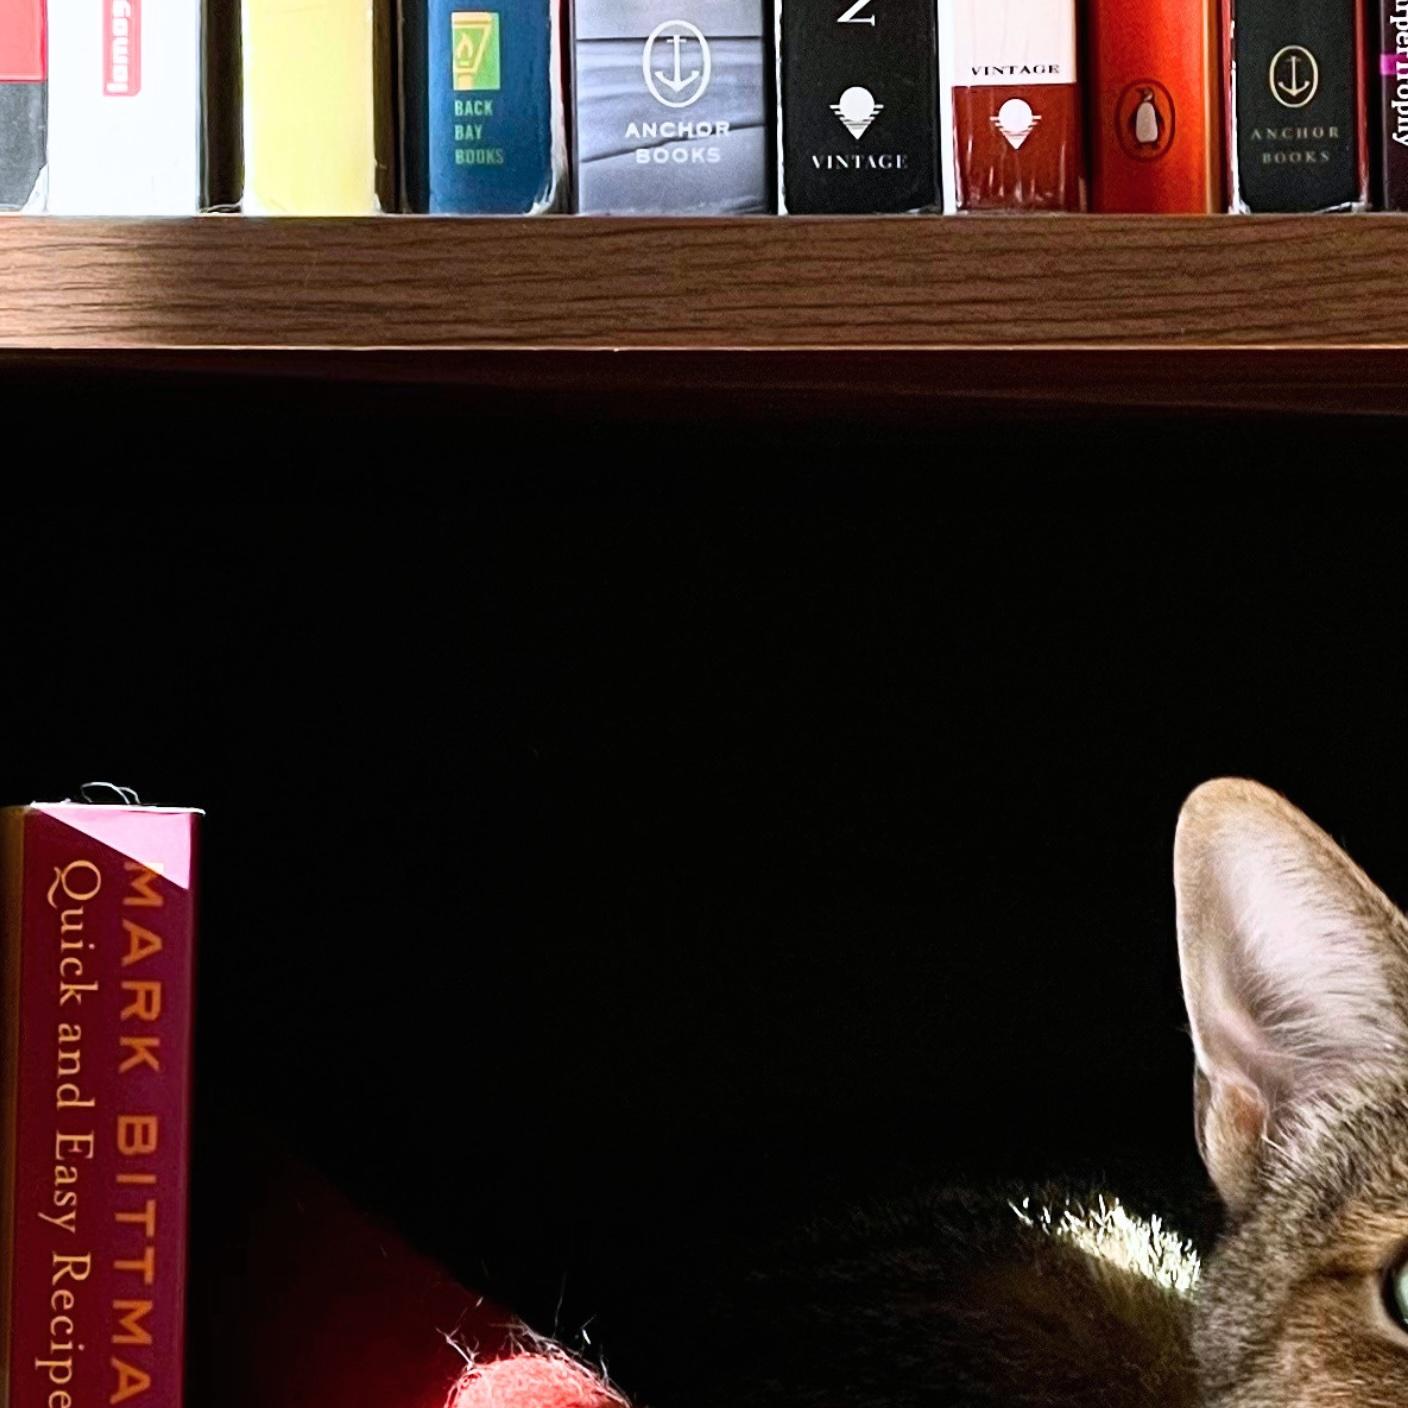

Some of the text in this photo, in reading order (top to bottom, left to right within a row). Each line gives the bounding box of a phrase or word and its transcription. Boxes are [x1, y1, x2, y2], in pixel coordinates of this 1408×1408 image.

[971, 65, 1060, 76] VINTAGE
[455, 100, 493, 116] BACK
[455, 125, 482, 141] BAY
[625, 121, 731, 139] ANCHOR
[1251, 127, 1339, 141] ANCHOR
[455, 148, 504, 164] BOOKS
[635, 147, 721, 164] BOOKS
[812, 155, 908, 169] VINTAGE
[1262, 152, 1330, 164] BOOKS
[47, 860, 101, 1007] Quick
[118, 860, 164, 1074] MARK
[56, 1023, 95, 1110] and
[38, 1130, 94, 1233] Easy
